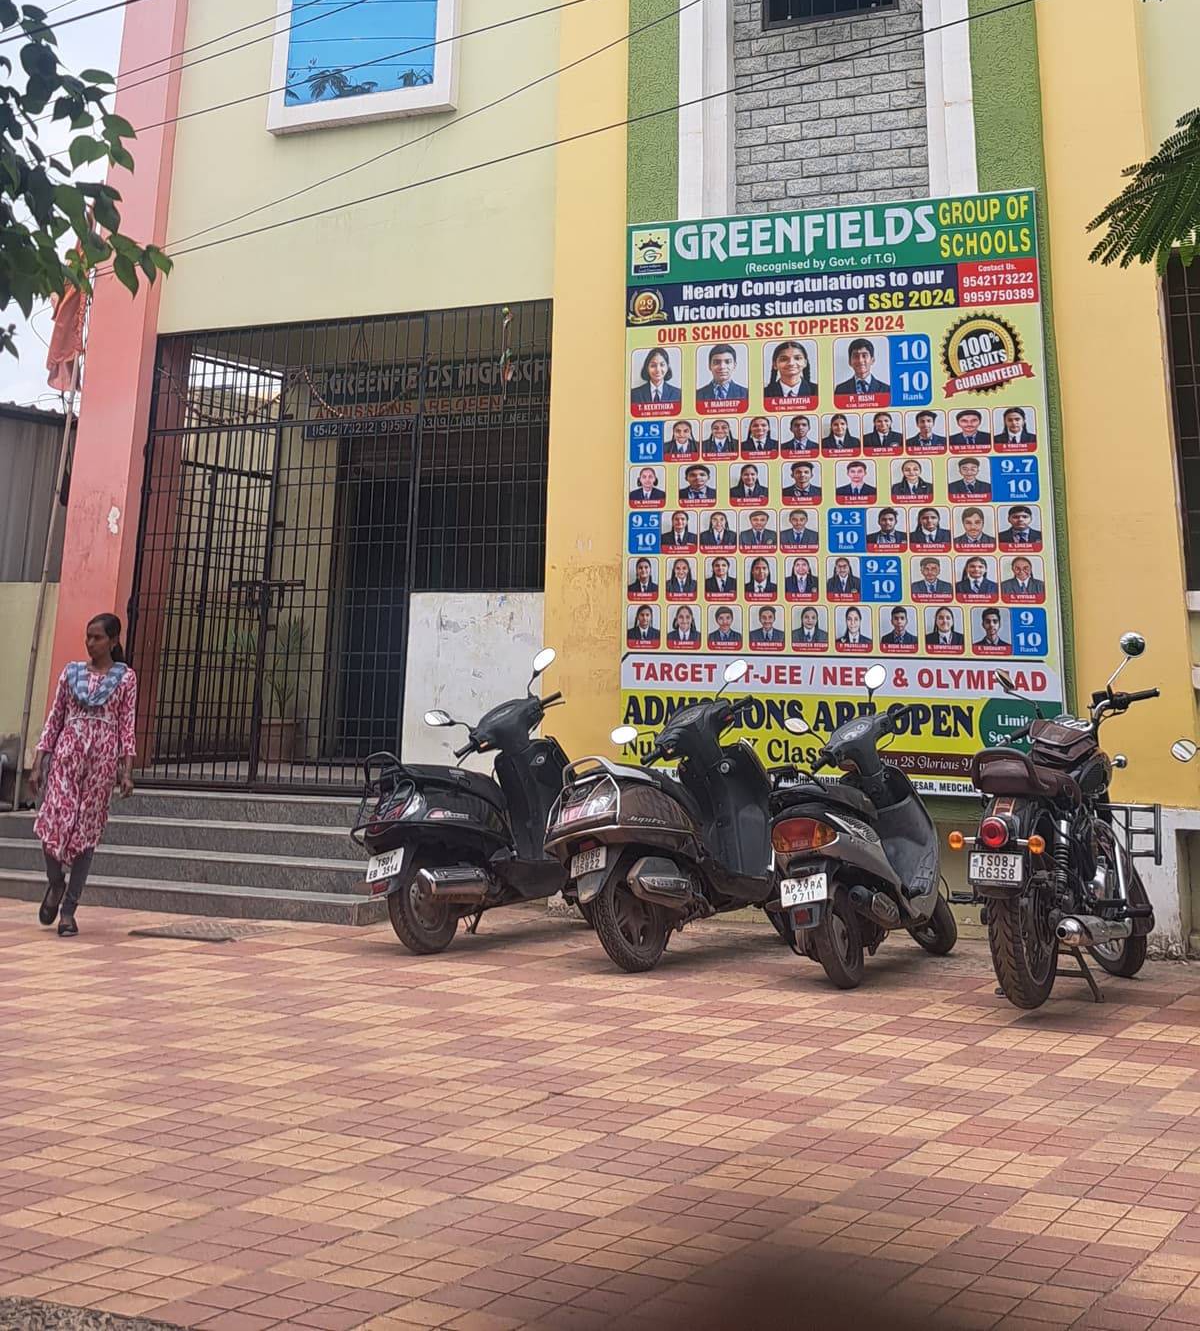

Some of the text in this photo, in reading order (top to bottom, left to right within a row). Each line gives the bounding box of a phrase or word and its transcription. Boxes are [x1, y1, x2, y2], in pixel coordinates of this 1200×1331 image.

[938, 195, 1029, 226] GROUP OF
[674, 205, 937, 262] GREENFIELDS
[940, 227, 1032, 259] SCHOOLS
[745, 252, 897, 275] (Recognised by Govt. of T.G)
[682, 269, 945, 301] Hearty Congratulations to our
[962, 272, 1034, 288] 9542173222
[963, 287, 1035, 304] 9959750389
[673, 302, 761, 322] Victorious
[764, 297, 845, 317] students
[847, 293, 866, 311] of
[868, 290, 905, 310] SSC
[908, 287, 956, 308] 2024
[657, 314, 905, 343] OUR SCHOOL SSC TOPPERS 2024
[898, 339, 928, 361] 10
[958, 331, 1001, 358] 100%
[959, 347, 1008, 373] RESULTS
[899, 370, 929, 393] 10
[954, 362, 1024, 391] GUARANTEED!
[633, 423, 661, 438] 9.8
[637, 442, 657, 455] 10
[1000, 459, 1035, 473] 9.7
[1007, 479, 1032, 493] 10
[632, 514, 659, 527] 9.5
[830, 511, 861, 525] 9.3
[636, 533, 657, 546] 10
[836, 531, 858, 544] 10
[865, 559, 898, 574] 9.2
[871, 579, 896, 593] 10
[1019, 611, 1034, 626] 9
[1016, 632, 1042, 647] 10
[632, 662, 718, 683] TARGET
[808, 665, 815, 686] /
[822, 666, 868, 686] NEE
[893, 668, 909, 688] &
[917, 668, 1047, 692] OLYMPAD
[887, 703, 974, 738] OPEN
[900, 755, 915, 769] 28
[917, 756, 960, 771] Glorious
[979, 854, 1016, 868] TS08J
[978, 866, 1015, 880] R6358
